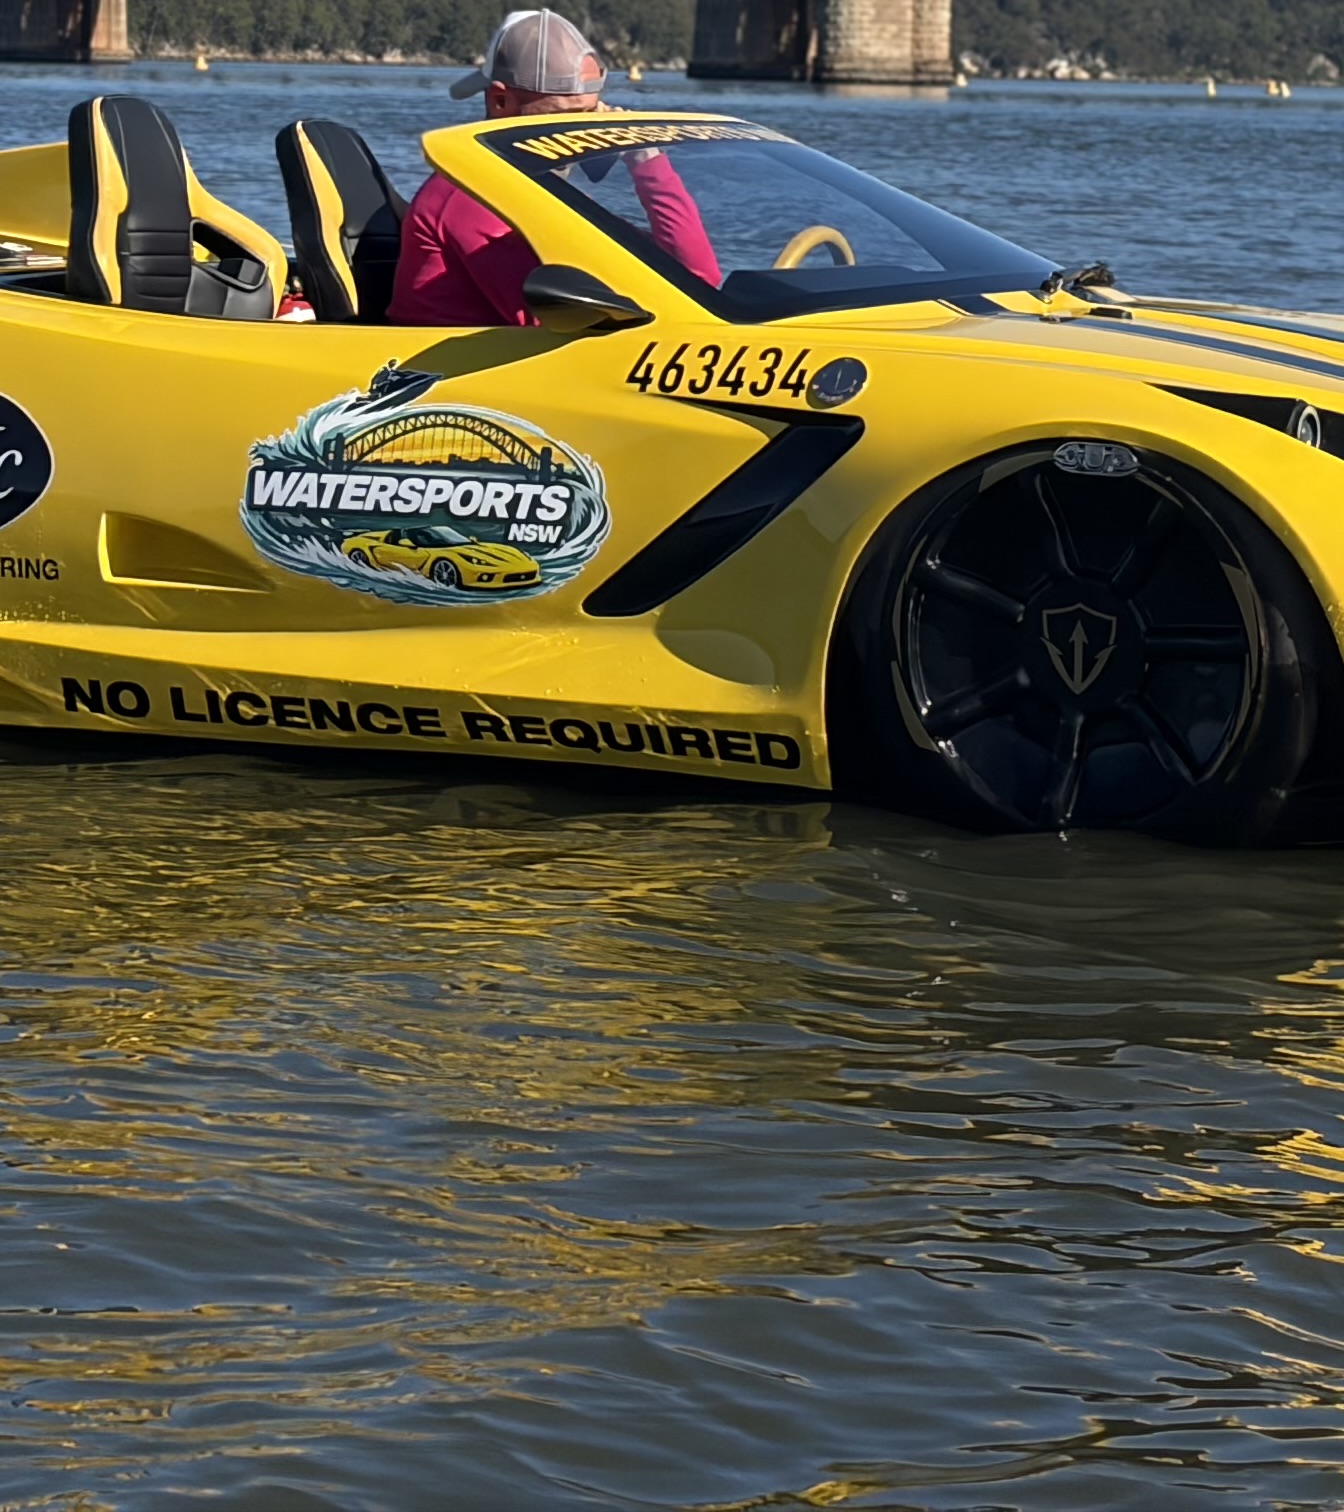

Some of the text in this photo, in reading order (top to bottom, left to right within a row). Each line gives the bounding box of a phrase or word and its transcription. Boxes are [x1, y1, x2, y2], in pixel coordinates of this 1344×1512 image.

[625, 341, 812, 398] 463434
[253, 470, 571, 521] WATERSPORTS
[508, 523, 563, 544] NSW
[61, 677, 802, 770] NO LICENCE REQUIRED
